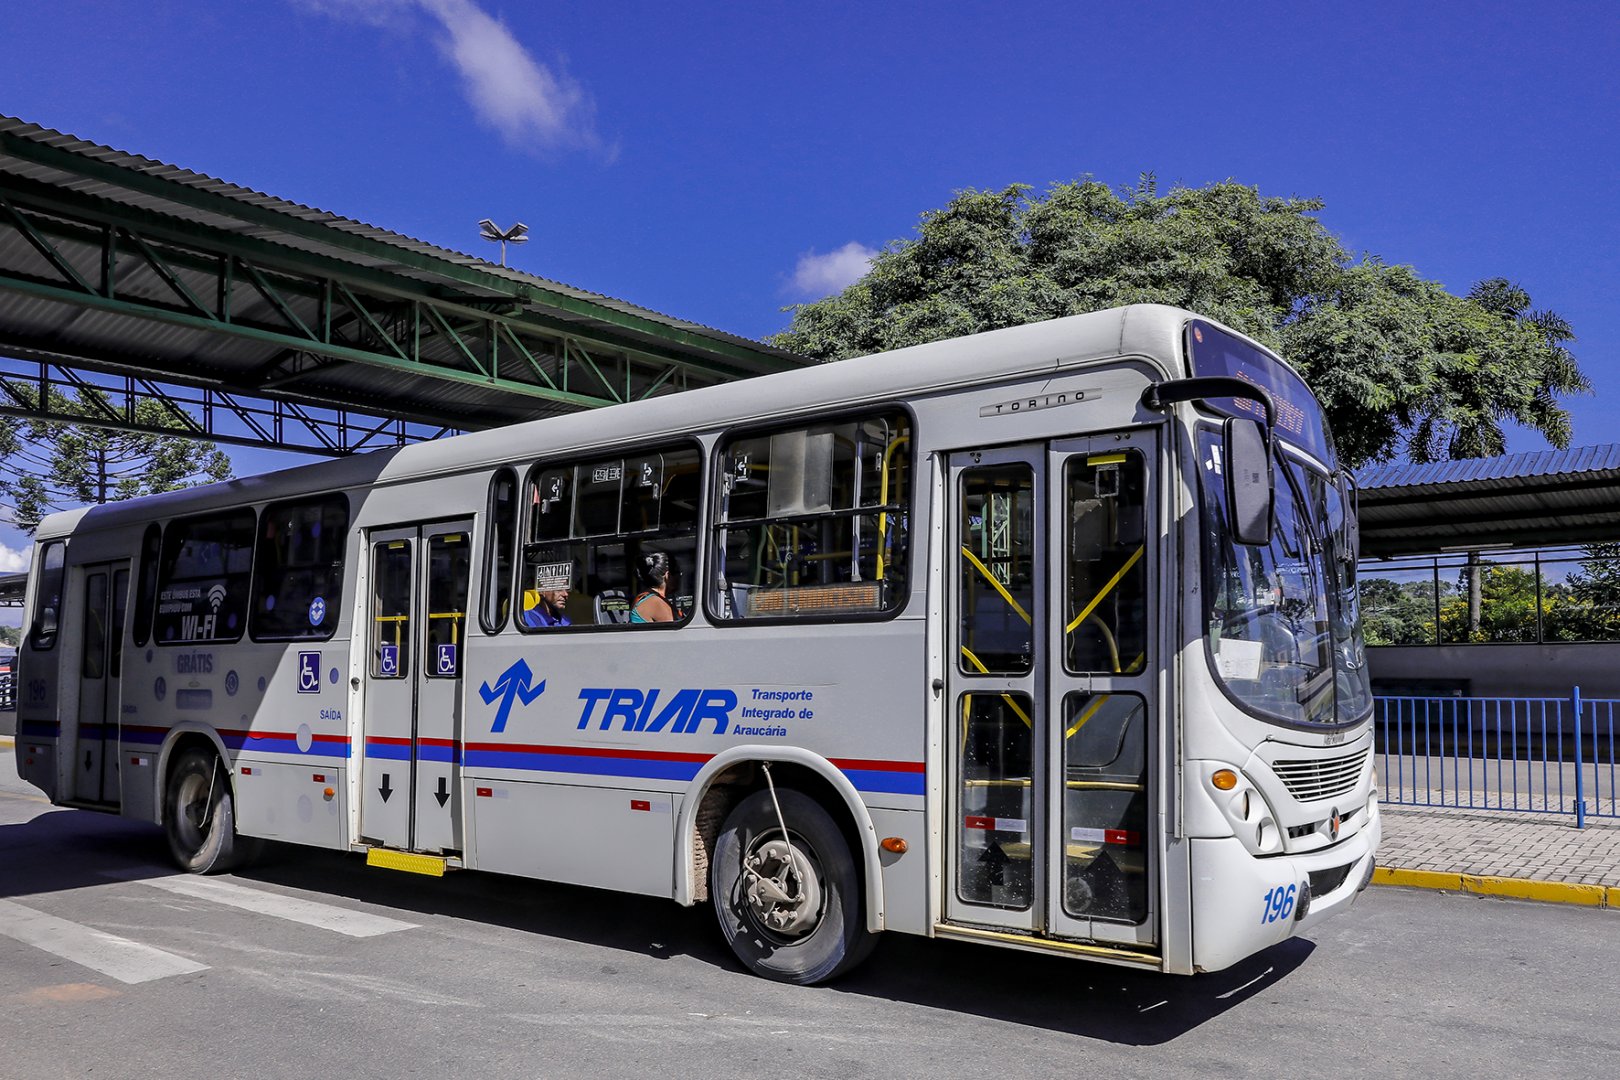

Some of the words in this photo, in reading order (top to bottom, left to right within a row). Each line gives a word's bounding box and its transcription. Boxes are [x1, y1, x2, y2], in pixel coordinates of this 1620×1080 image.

[995, 391, 1085, 413] TORINO
[177, 649, 213, 674] GRÁTIS
[752, 689, 813, 703] Transporte
[320, 708, 341, 720] SAÍDA
[577, 688, 738, 734] TRIAR
[741, 706, 796, 721] Integrado
[798, 707, 814, 720] de
[733, 724, 787, 737] Araucária
[1261, 883, 1296, 925] 196
